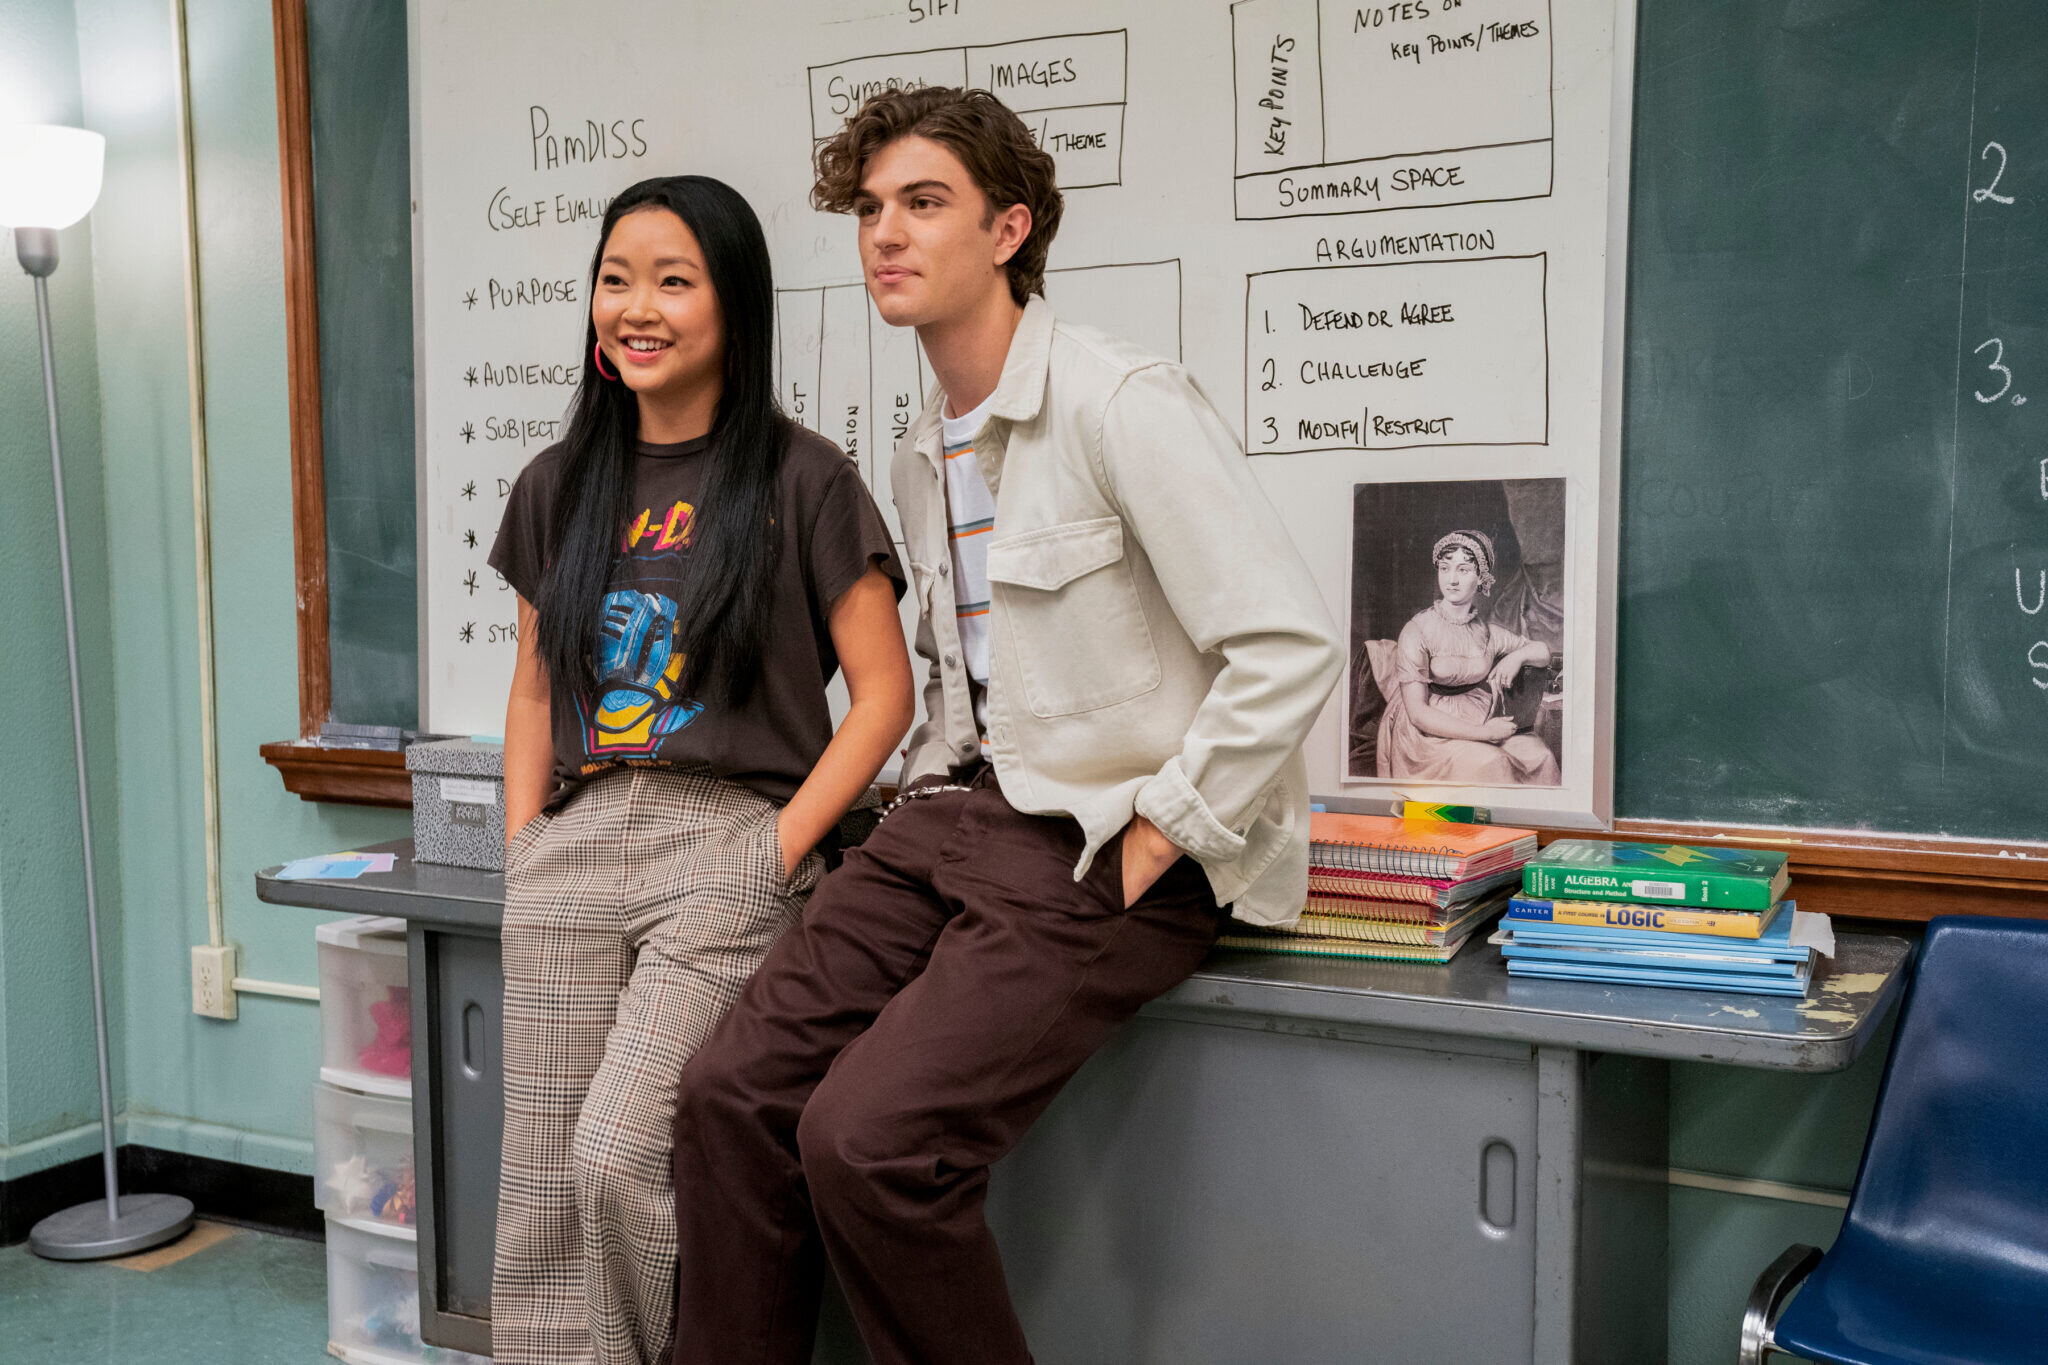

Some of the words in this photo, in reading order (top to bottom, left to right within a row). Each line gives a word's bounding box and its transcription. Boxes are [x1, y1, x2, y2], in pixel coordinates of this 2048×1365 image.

[1353, 0, 1430, 34] NOTES
[1391, 42, 1421, 64] KEY
[990, 57, 1077, 95] IMAGES
[1258, 33, 1296, 111] POINTS
[1050, 132, 1107, 153] THEME
[1263, 117, 1292, 156] KEY
[1278, 177, 1381, 207] SUMMARY
[1390, 166, 1465, 191] SPACE
[1973, 141, 2015, 205] 2
[487, 186, 547, 232] (SELF
[1315, 229, 1496, 263] ARGUMENTATION
[488, 278, 577, 310] PURPOSE
[1264, 309, 1277, 334] 1.
[1298, 302, 1364, 331] DEFEND
[1367, 309, 1394, 328] OR
[1400, 301, 1455, 326] AGREE
[484, 361, 581, 388] AUDIENCE
[1261, 358, 1283, 391] 2.
[1300, 358, 1427, 384] CHALLENGE
[1974, 337, 2028, 404] 3.
[485, 416, 561, 448] SUBJECT
[1262, 416, 1279, 445] 3
[1563, 887, 1591, 896] Structure
[1591, 888, 1604, 896] and
[1604, 889, 1628, 898] Method
[1564, 874, 1619, 888] ALGEBRA
[1514, 906, 1550, 915] CARTER
[1605, 908, 1666, 929] LOGIC
